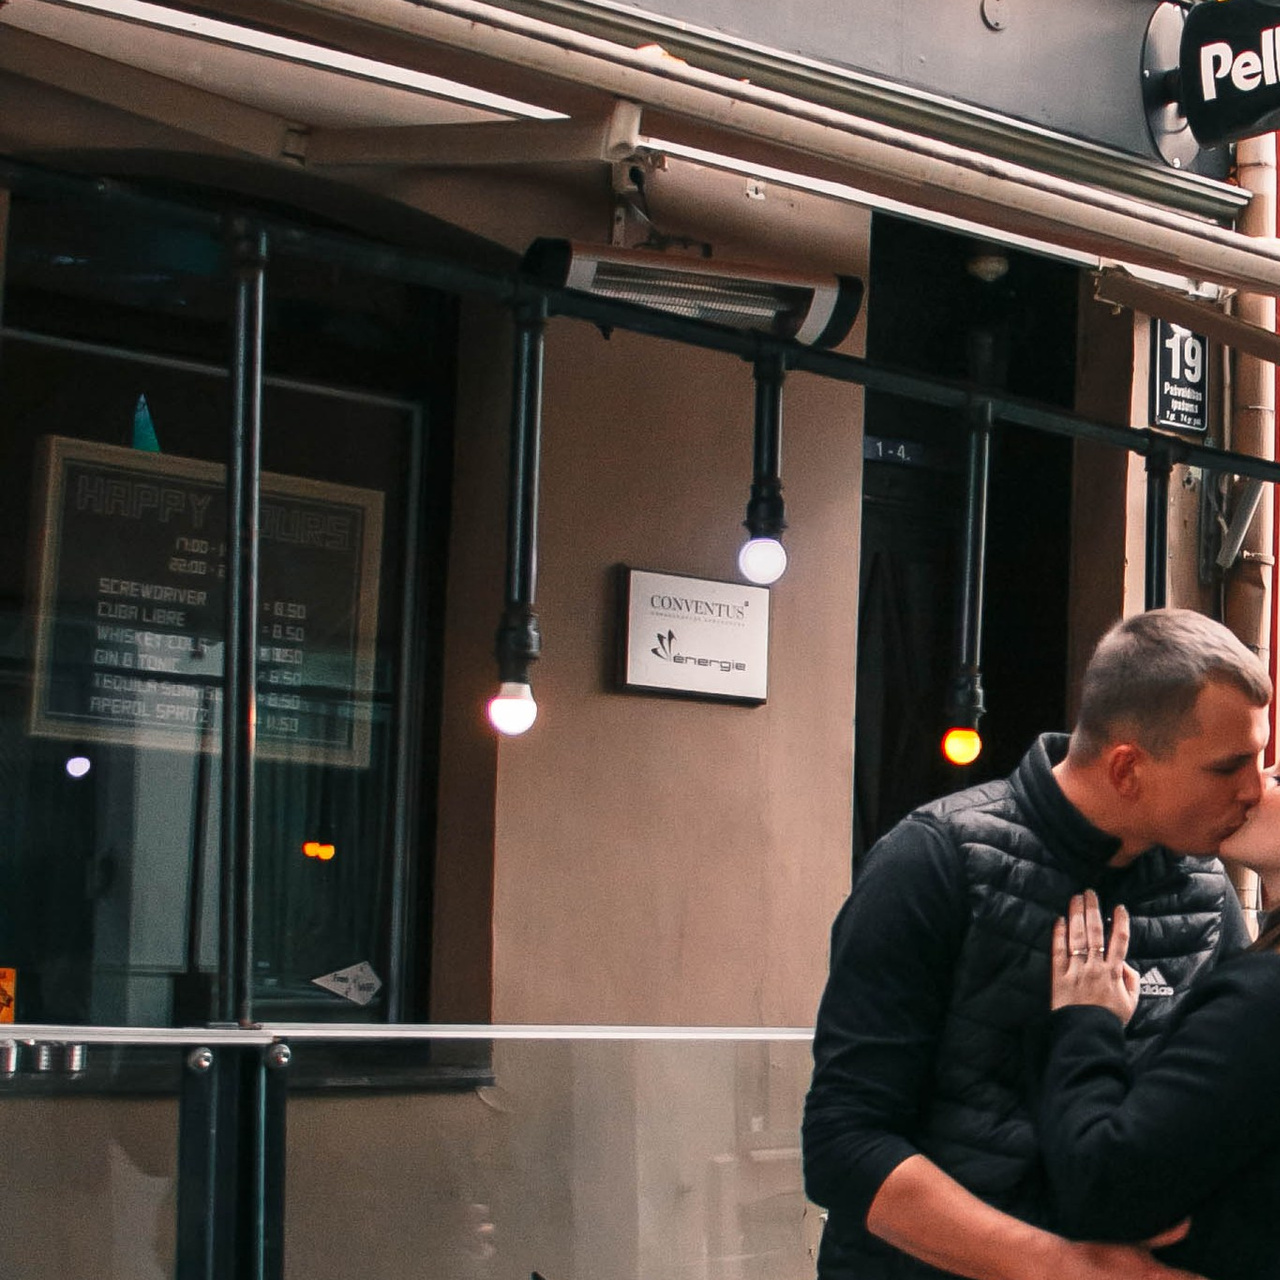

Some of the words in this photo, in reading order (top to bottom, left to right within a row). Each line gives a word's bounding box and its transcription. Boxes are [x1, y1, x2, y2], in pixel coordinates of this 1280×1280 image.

[1165, 332, 1202, 383] 19
[76, 475, 212, 529] HAPPY
[258, 504, 352, 552] OURS
[99, 578, 207, 606] SCREWDRIVER
[97, 601, 138, 620] CUBA
[142, 607, 187, 627] LIBRE
[651, 595, 745, 620] CONVENTUS
[90, 696, 151, 718] APEROL
[1140, 984, 1174, 996] didas
